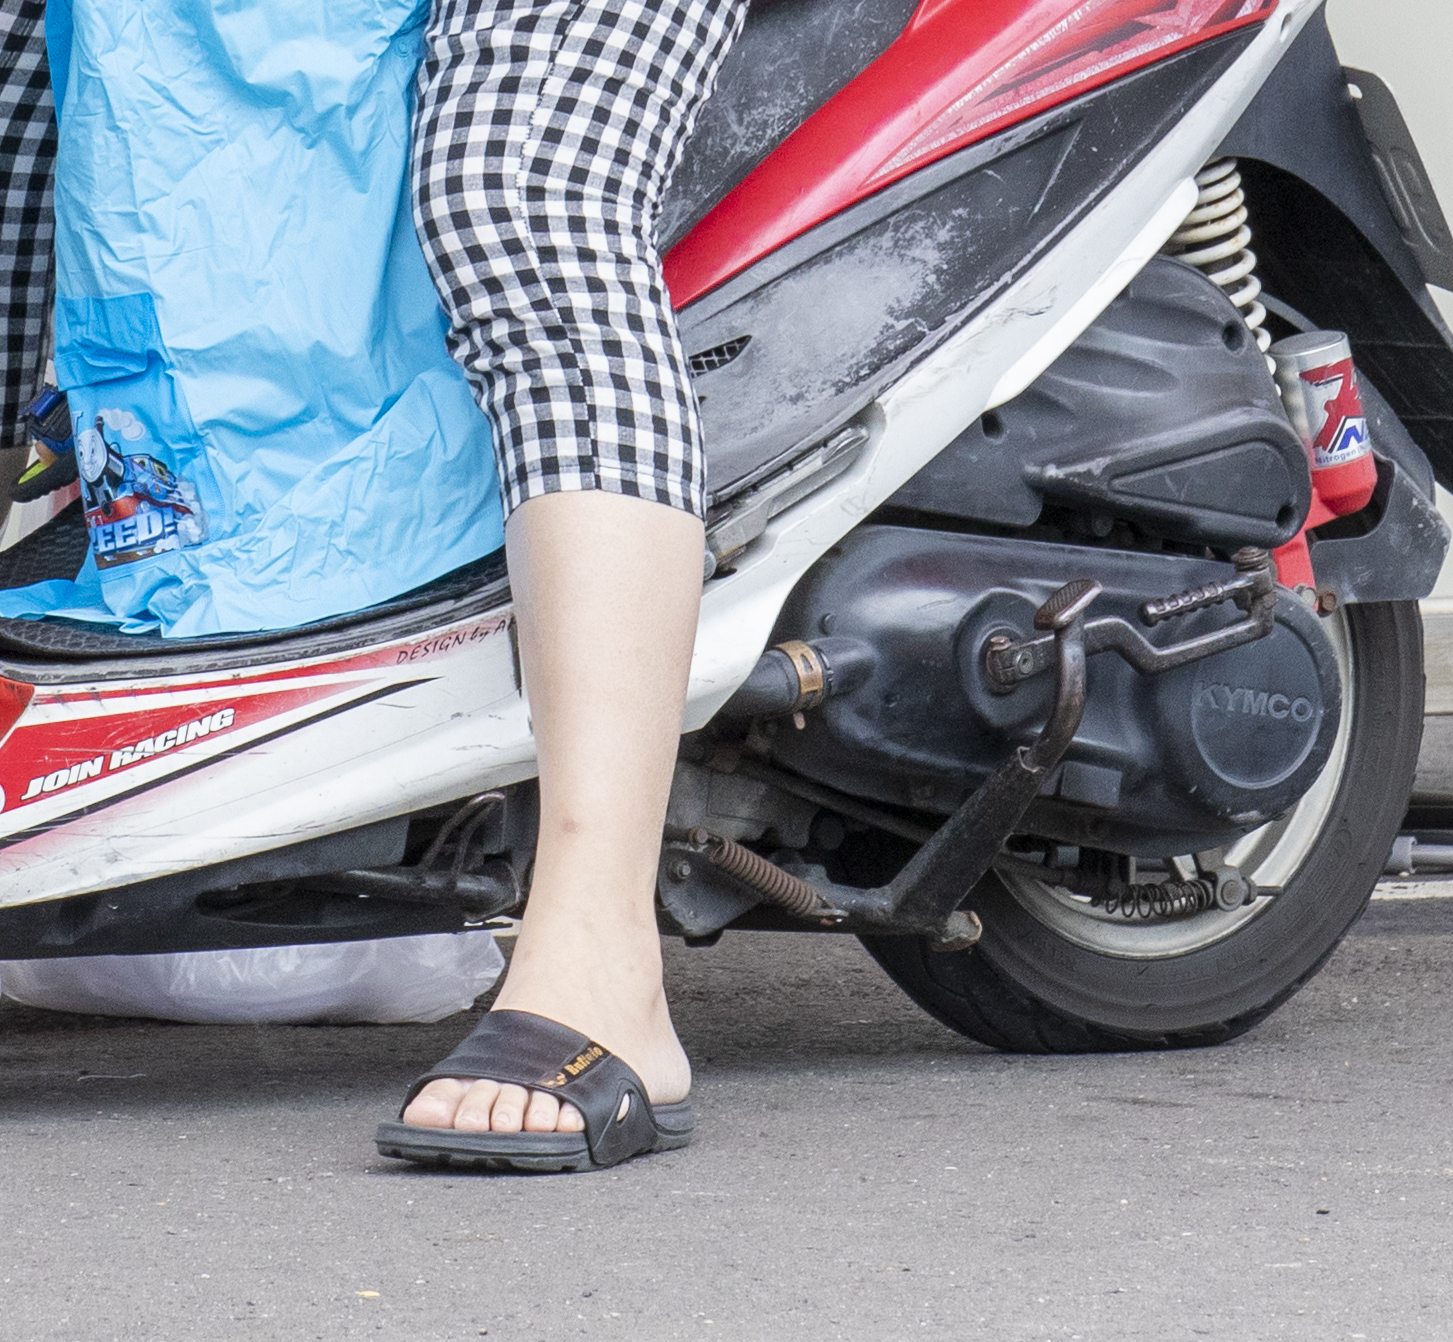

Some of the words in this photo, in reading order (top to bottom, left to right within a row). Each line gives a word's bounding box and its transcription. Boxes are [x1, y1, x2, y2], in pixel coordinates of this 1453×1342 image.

[396, 631, 467, 665] DESIGN
[470, 626, 490, 643] by
[1194, 681, 1314, 722] KYMCO
[20, 755, 104, 801] JOIN
[108, 708, 235, 771] RACING
